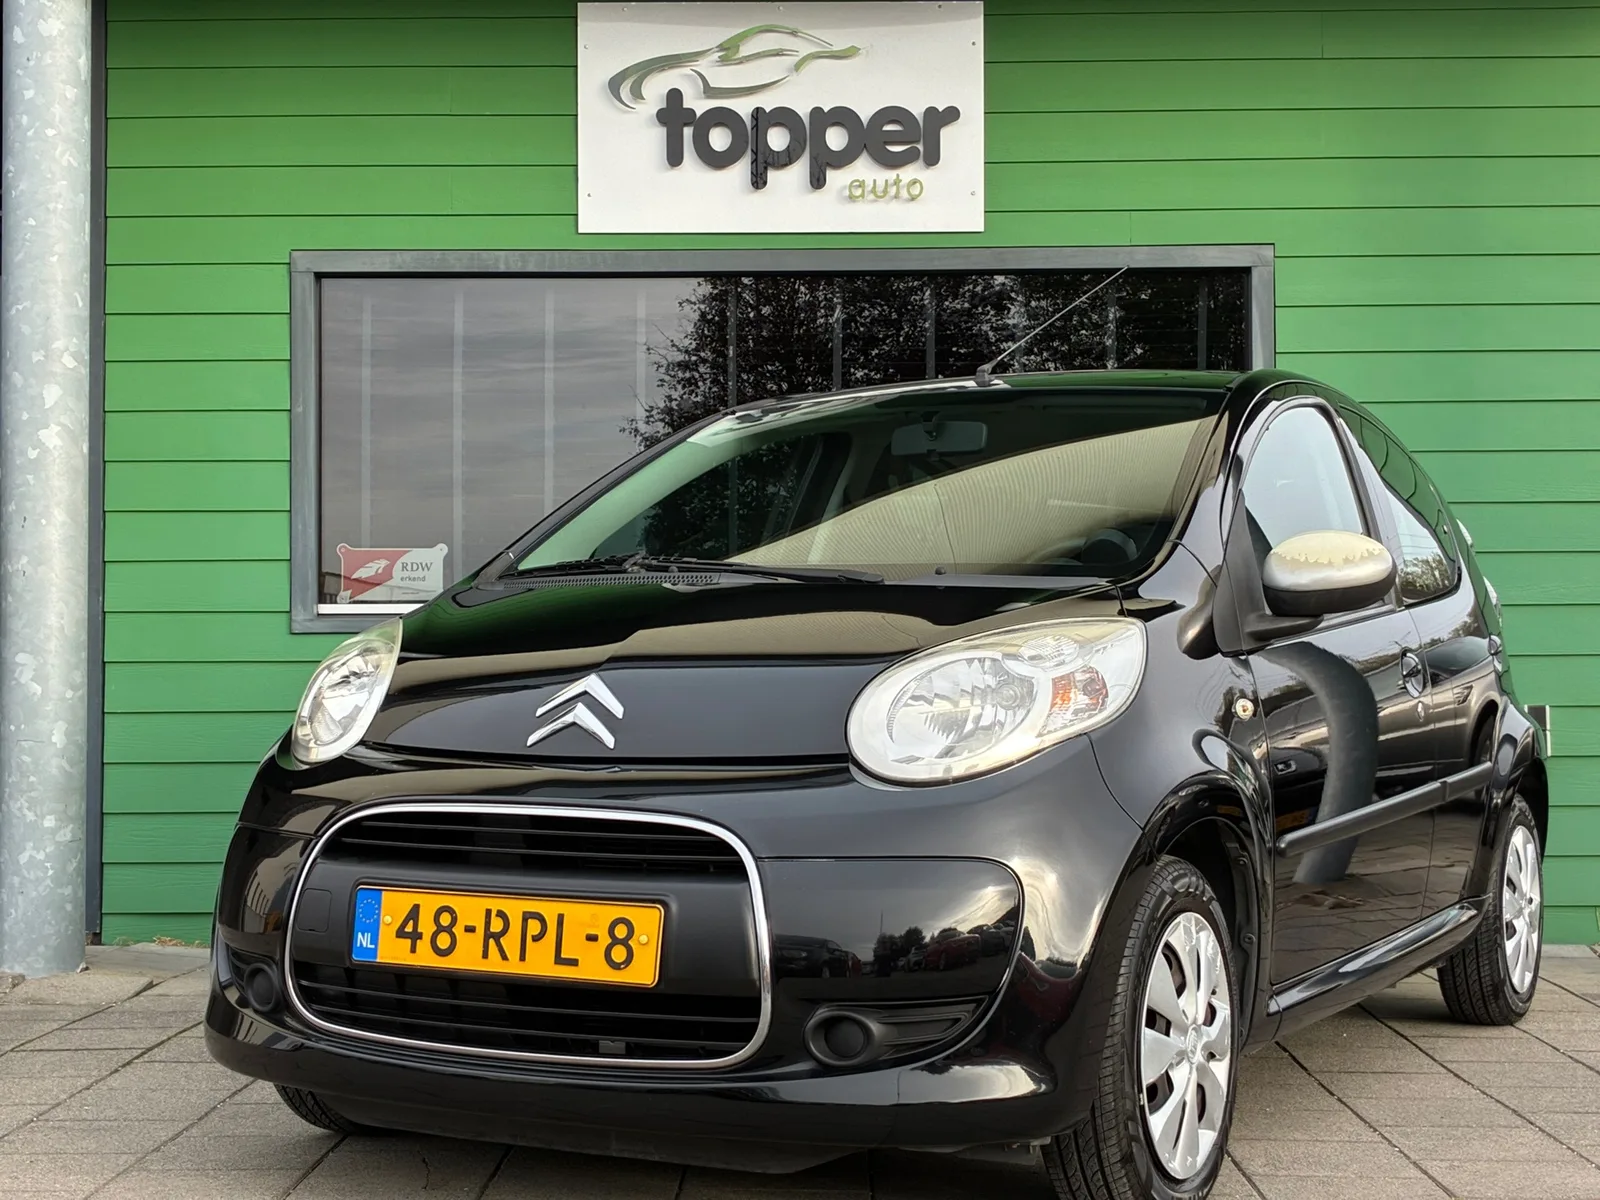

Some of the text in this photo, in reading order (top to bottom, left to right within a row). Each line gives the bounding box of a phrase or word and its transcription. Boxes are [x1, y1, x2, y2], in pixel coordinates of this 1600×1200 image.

[656, 87, 961, 190] topper
[847, 173, 924, 200] auto
[401, 561, 433, 572] RDW
[357, 932, 375, 948] NL
[395, 903, 636, 970] 48-RPL-8
